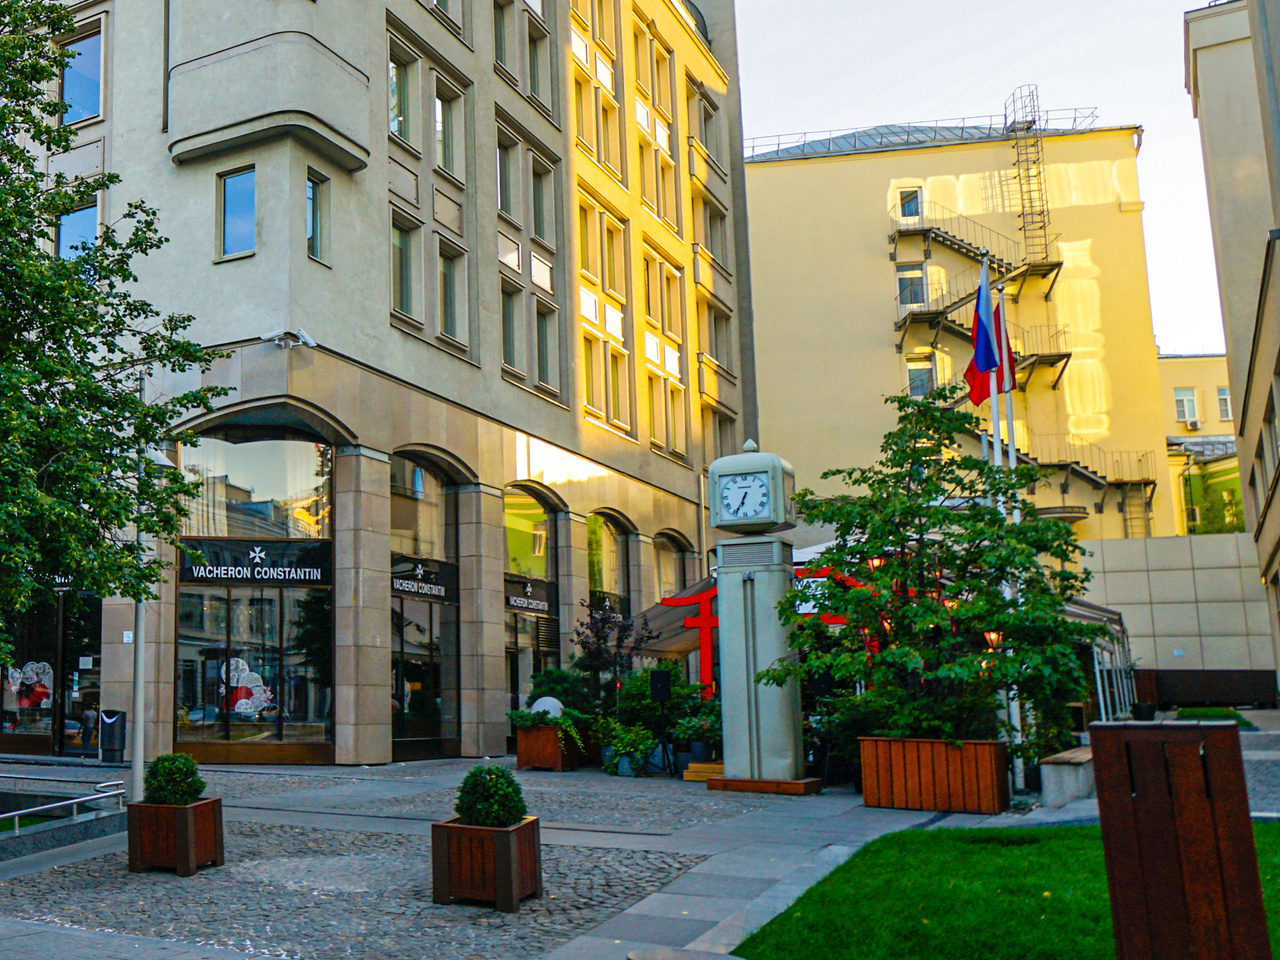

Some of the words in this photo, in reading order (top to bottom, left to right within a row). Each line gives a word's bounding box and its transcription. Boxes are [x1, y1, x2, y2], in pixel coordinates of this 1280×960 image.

[192, 566, 251, 579] VACHERON
[254, 567, 321, 580] CONSTANTIN
[393, 578, 418, 592] VACHERON
